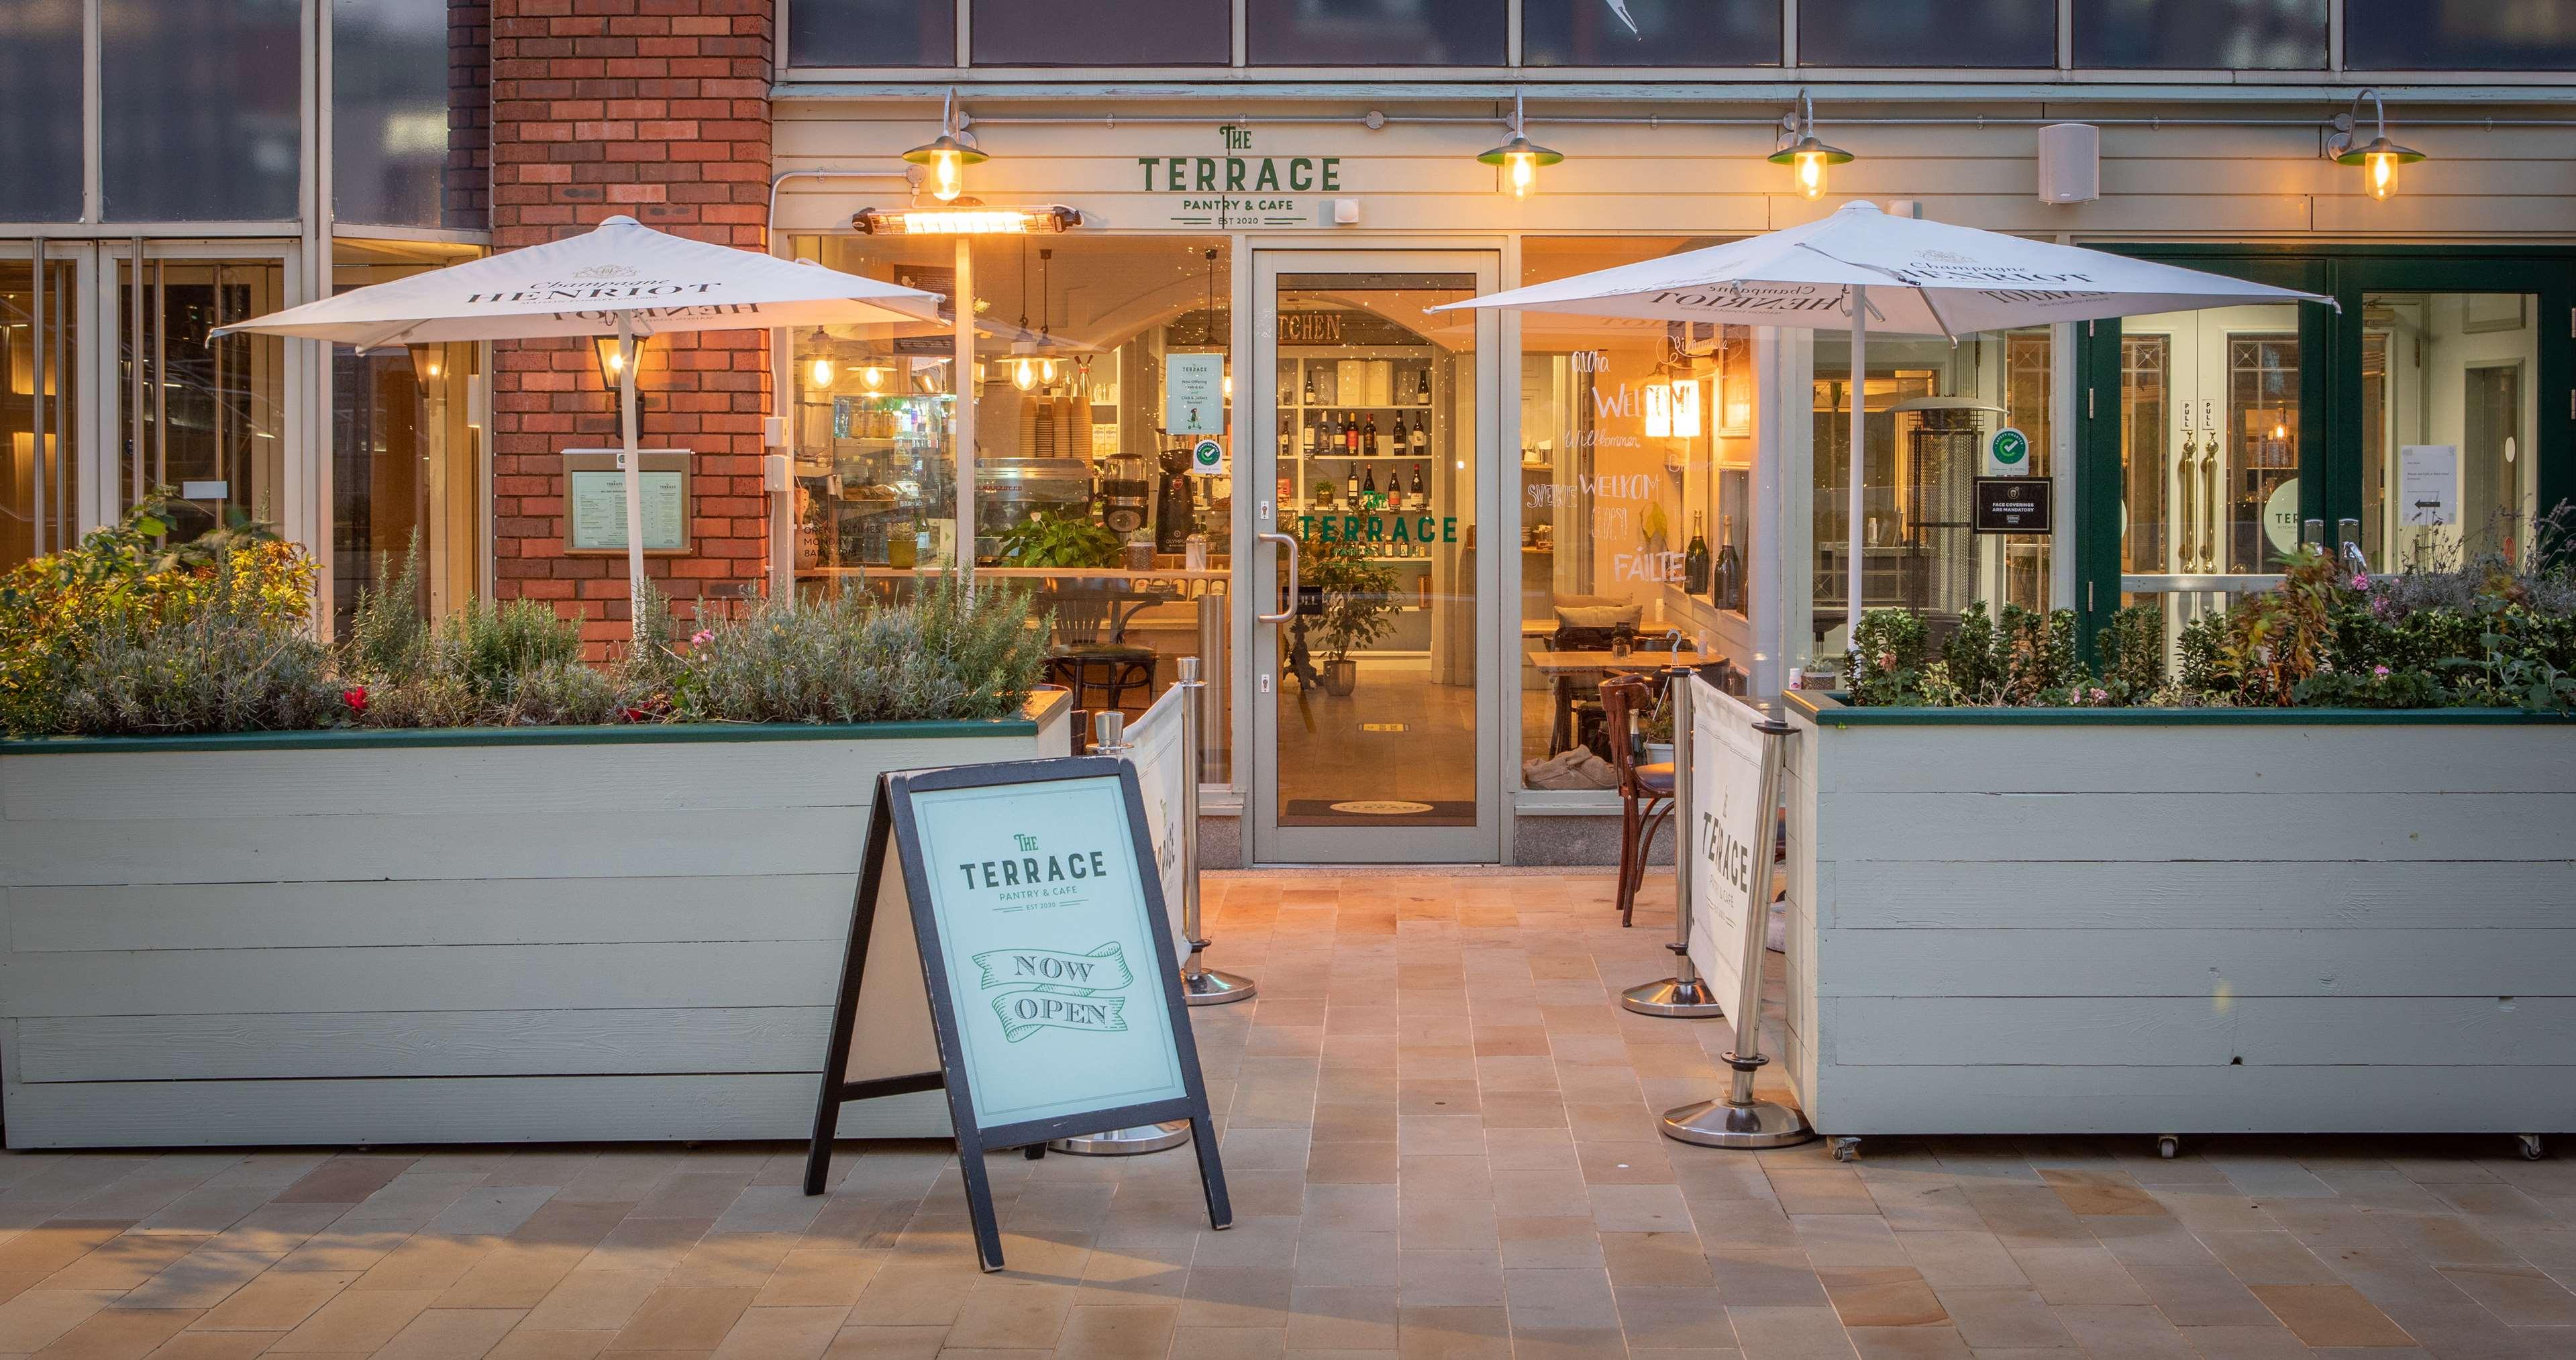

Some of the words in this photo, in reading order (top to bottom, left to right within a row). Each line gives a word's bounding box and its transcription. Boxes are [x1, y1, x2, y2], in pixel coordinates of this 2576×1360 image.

[1138, 158, 1341, 192] TERRACE
[1183, 200, 1241, 211] PANTRY
[1245, 200, 1254, 211] &
[1258, 200, 1294, 211] CAFE
[1218, 217, 1234, 225] EST
[1237, 217, 1259, 225] 2020
[1910, 262, 2028, 272] Champagne
[529, 278, 670, 290] Champagne
[466, 282, 722, 304] HENRIOT
[1995, 433, 2007, 445] SAFETY
[2008, 433, 2024, 445] CHARTER
[1578, 472, 1661, 501] WELKOM
[804, 526, 850, 535] OPENING
[852, 525, 882, 534] TIMES
[1298, 515, 1458, 543] TERRACE
[804, 538, 849, 546] MONDAY
[1013, 833, 1039, 852] THE
[960, 851, 1107, 890] TERRACE
[999, 890, 1039, 901] PANTRY
[1043, 888, 1049, 896] &
[1052, 886, 1078, 896] CAFE
[1013, 955, 1096, 983] NOW
[1014, 998, 1108, 1025] OPEN
